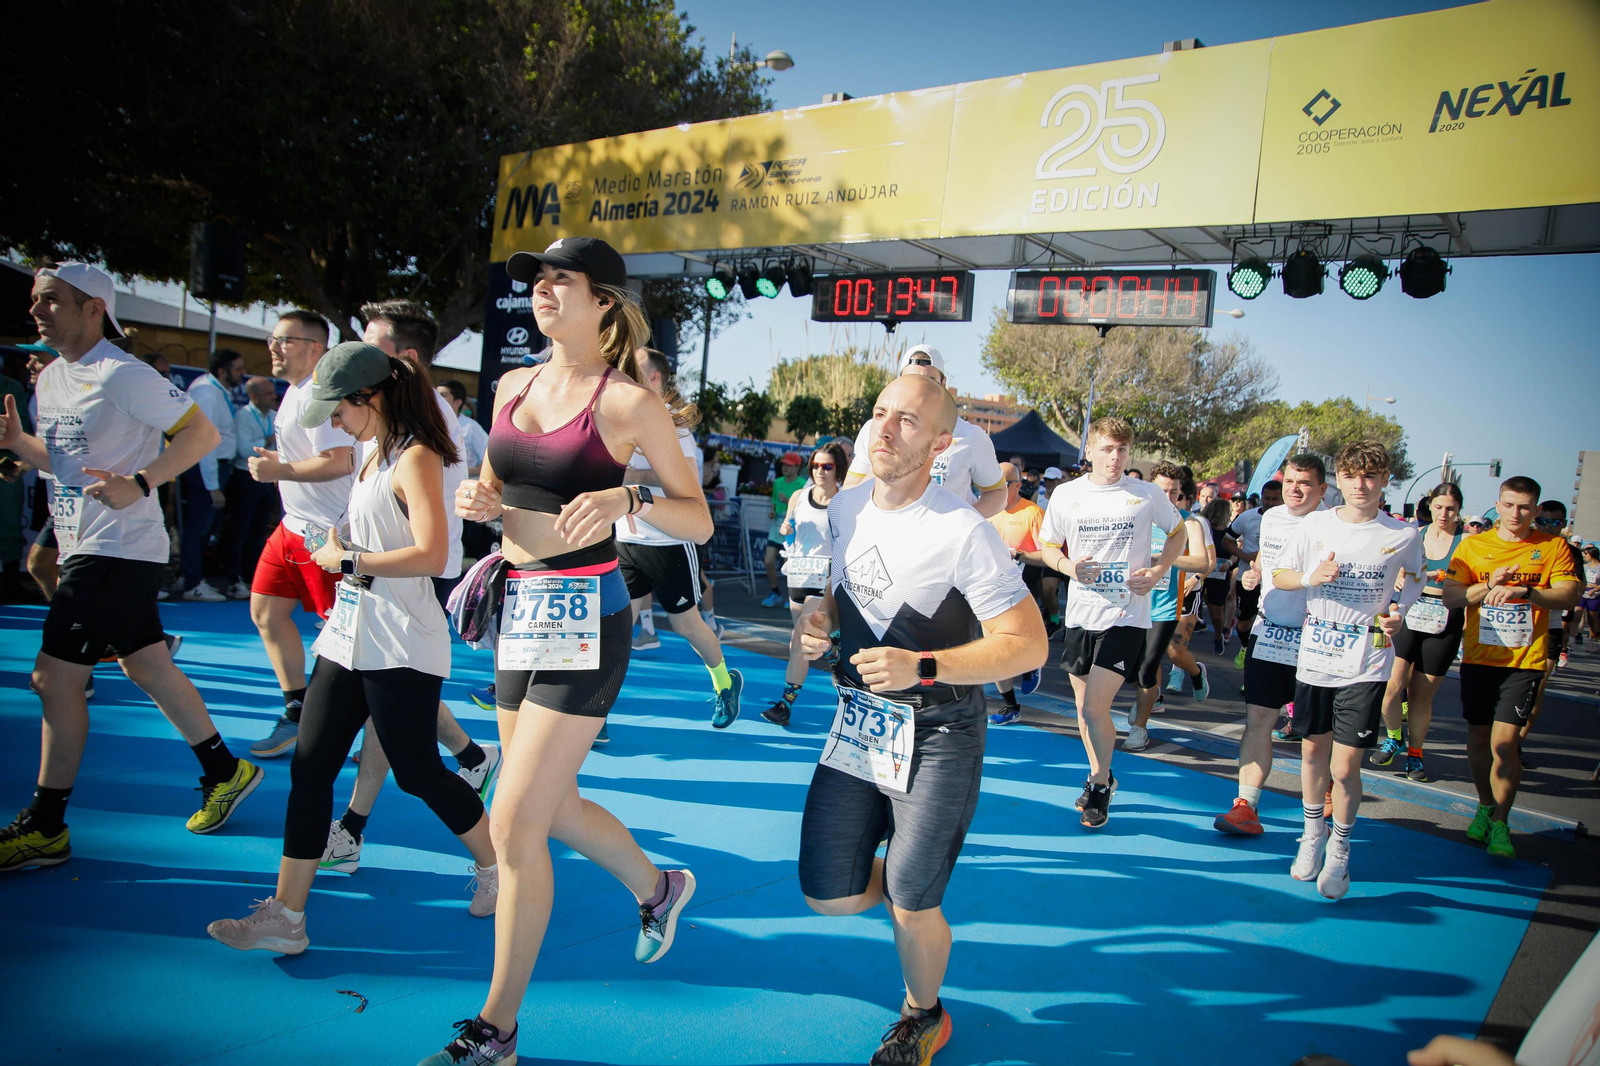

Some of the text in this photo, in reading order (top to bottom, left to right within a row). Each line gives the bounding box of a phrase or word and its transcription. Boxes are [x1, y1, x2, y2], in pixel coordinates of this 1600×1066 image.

[1035, 72, 1166, 180] 25
[1299, 122, 1402, 142] COOPERACIÓN
[1438, 122, 1465, 133] 2020
[1297, 142, 1331, 155] 2005
[593, 167, 722, 195] Medio Maratón
[731, 184, 898, 211] RAMÓN RUIZ ANDÚJAR
[1030, 178, 1160, 213] EDICIÓN
[589, 188, 719, 222] Almería 2024
[834, 276, 958, 316] 00:13:47
[59, 415, 83, 426] 2024
[933, 462, 947, 470] 24
[1103, 515, 1136, 523] Maratón
[1078, 522, 1135, 532] Almería 2024
[1348, 562, 1387, 571] Maratón
[1094, 570, 1125, 584] 086
[1339, 570, 1385, 579] ería 2024
[511, 594, 588, 621] 5758
[1486, 609, 1527, 624] 5622
[528, 621, 563, 629] CARMEN
[1311, 628, 1359, 650] 5087
[844, 701, 904, 741] 5737
